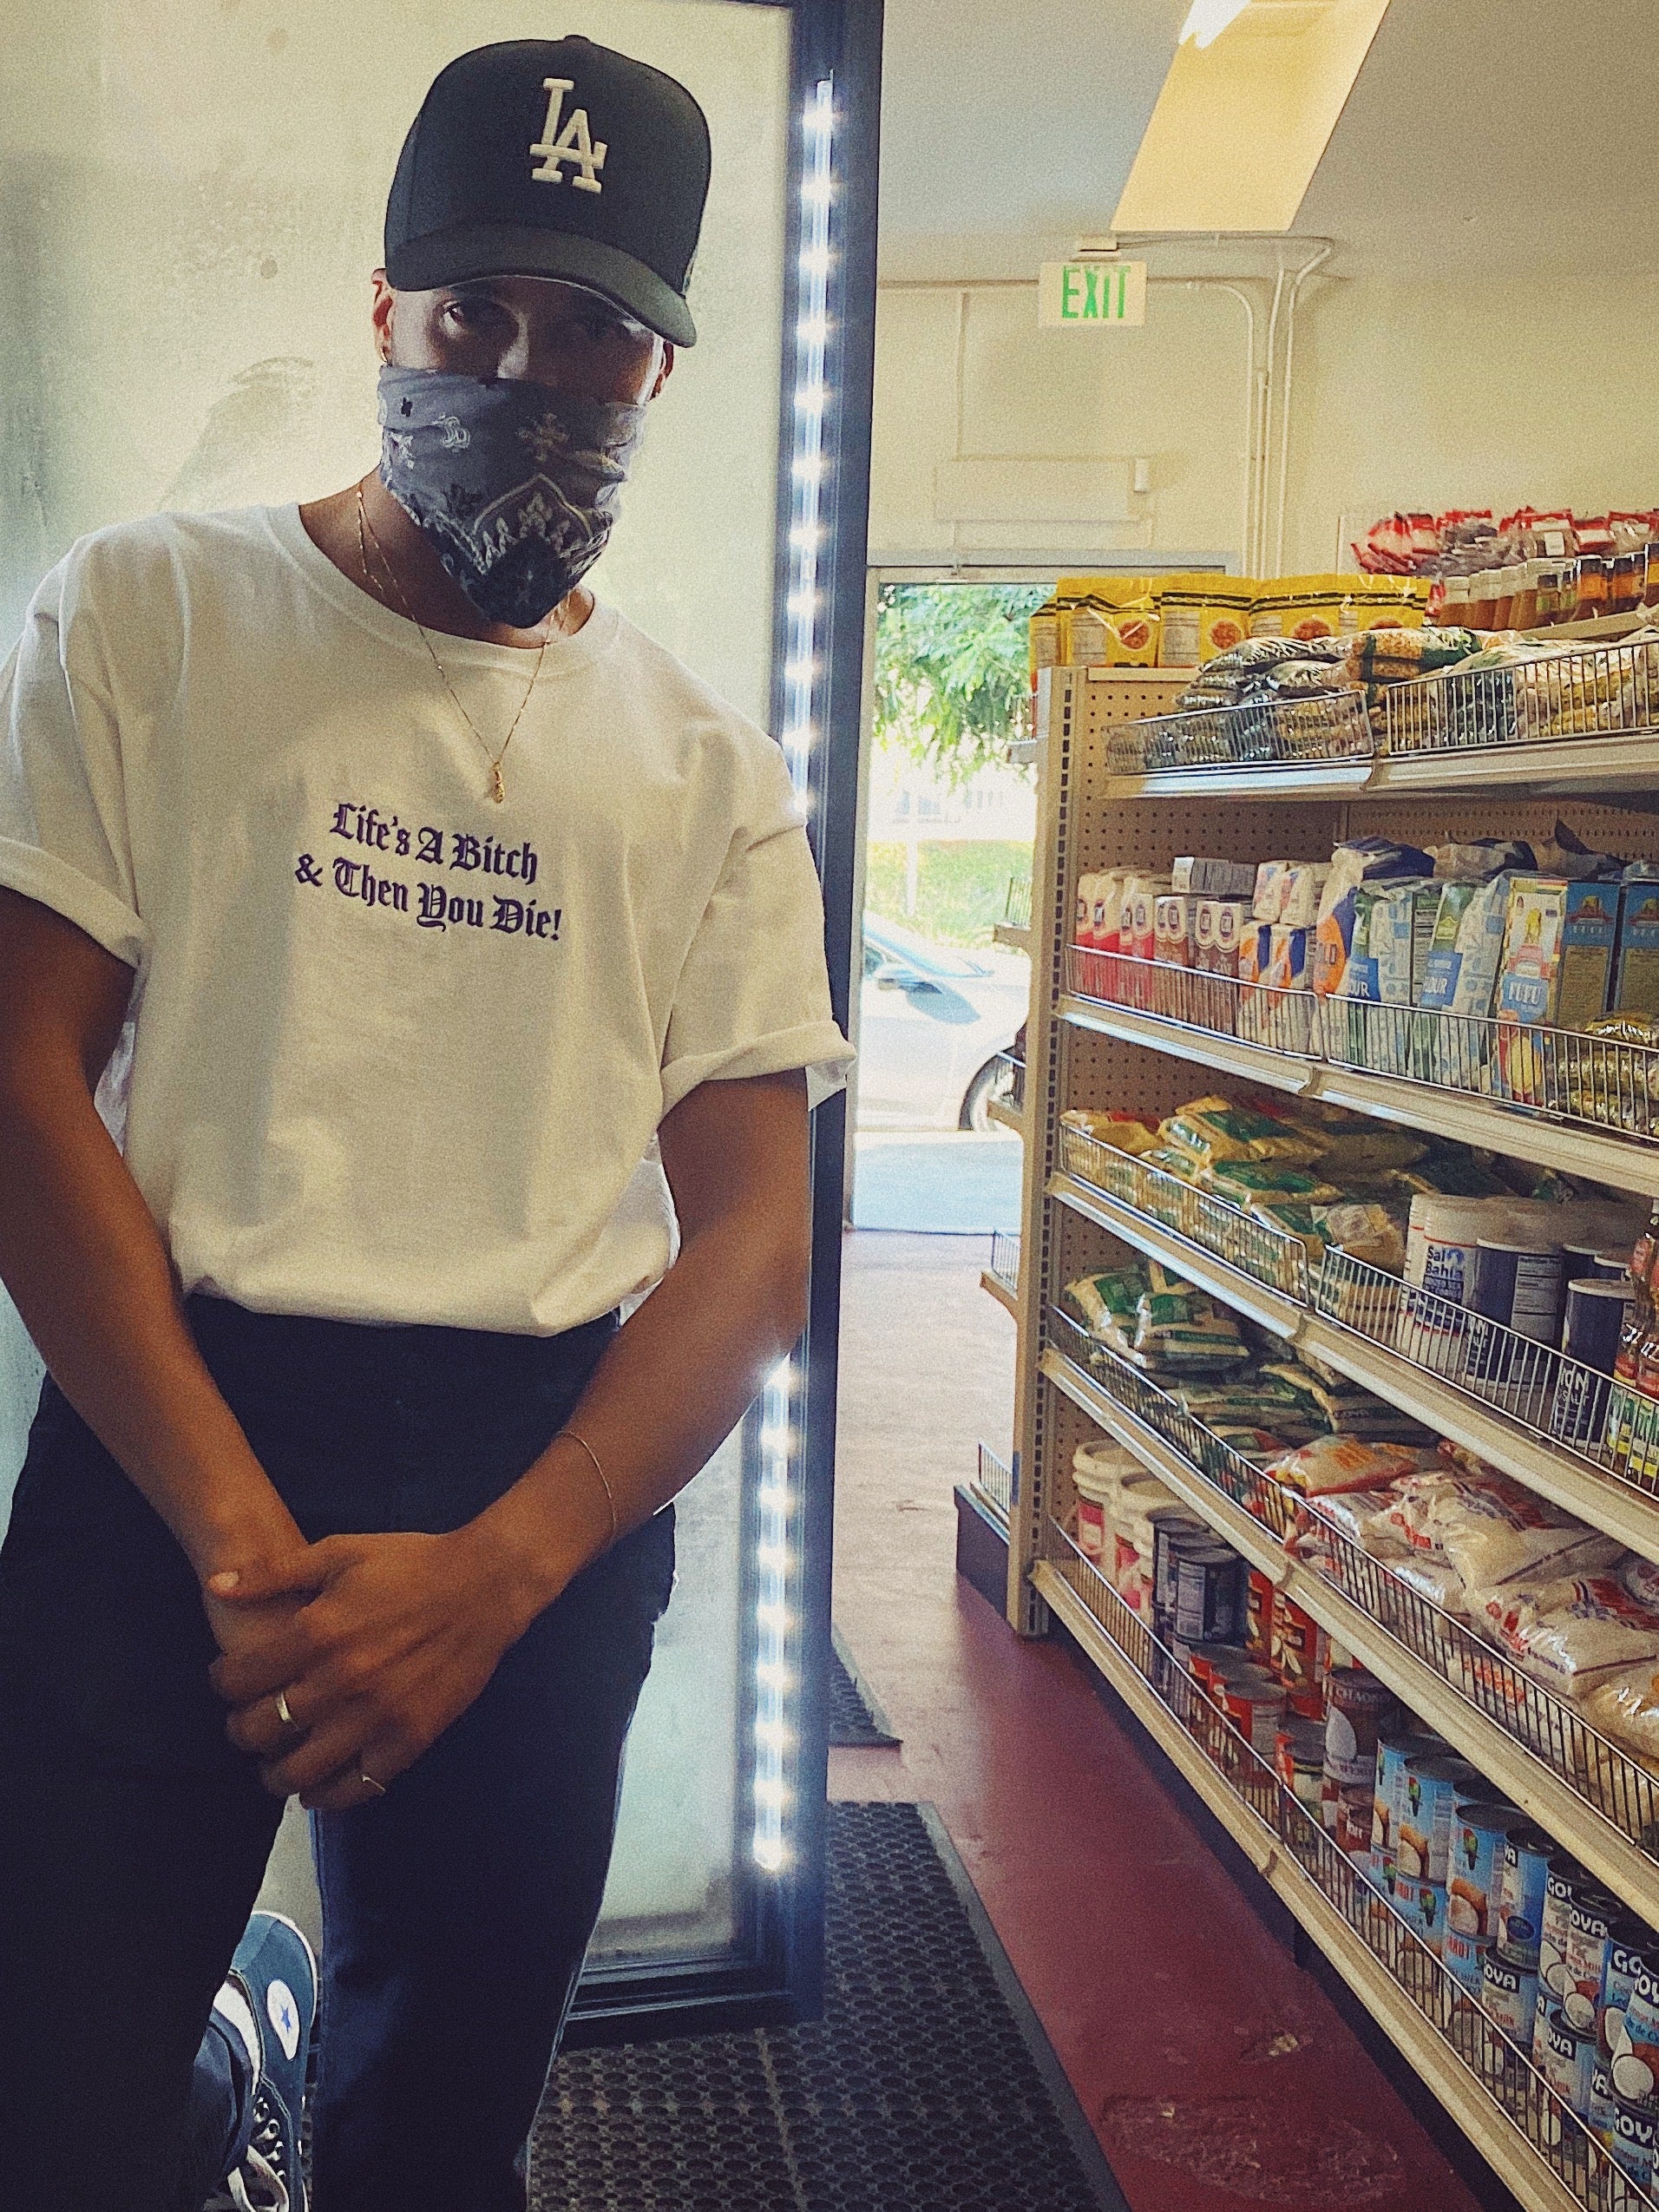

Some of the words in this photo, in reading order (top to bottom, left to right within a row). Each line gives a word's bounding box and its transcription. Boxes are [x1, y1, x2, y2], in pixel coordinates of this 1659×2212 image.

[529, 77, 607, 194] LA
[1062, 266, 1131, 318] EXIT
[330, 803, 411, 856] Life's
[416, 827, 443, 864] A
[449, 833, 538, 885] Bitch
[295, 854, 323, 887] &
[332, 857, 408, 912] Then
[416, 883, 483, 932] You
[490, 895, 562, 941] Die!
[1508, 981, 1541, 1005] FUFU
[1427, 1245, 1446, 1263] Sal
[1548, 1877, 1572, 1898] GO
[1570, 1909, 1608, 1937] OYA
[1614, 1949, 1642, 1975] GO
[1484, 1966, 1517, 1990] OYA
[1615, 2107, 1653, 2144] GOY
